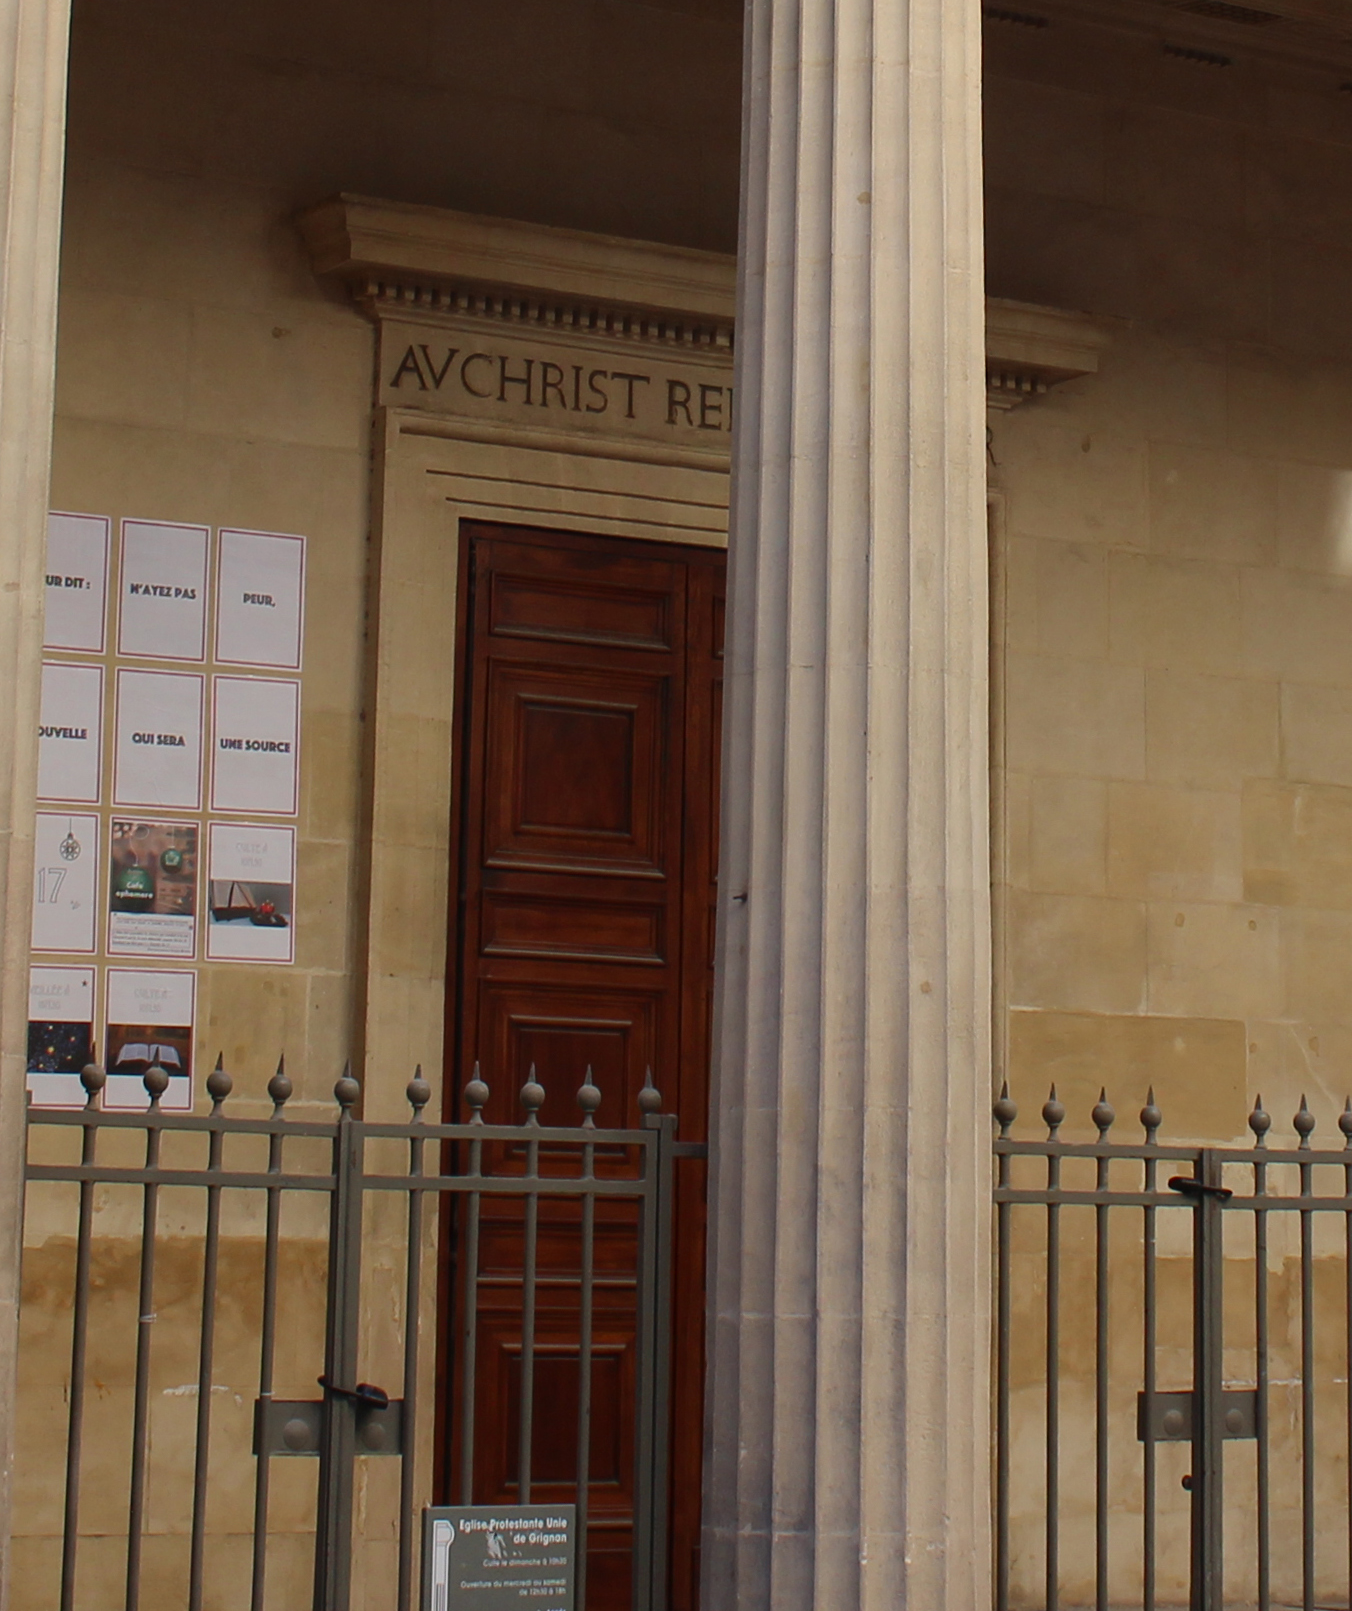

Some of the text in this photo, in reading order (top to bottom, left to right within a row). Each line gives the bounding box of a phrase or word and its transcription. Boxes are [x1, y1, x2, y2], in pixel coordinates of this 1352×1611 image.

[46, 575, 62, 586] UR
[130, 583, 196, 599] N'AYEZ PAS
[38, 725, 87, 739] OUVELLE
[132, 733, 185, 746] QUI SERA
[220, 738, 291, 753] UNE SOURCE
[38, 867, 67, 903] 17
[459, 1517, 567, 1533] Eglise Protestante Unie
[513, 1532, 567, 1545] de Grignan
